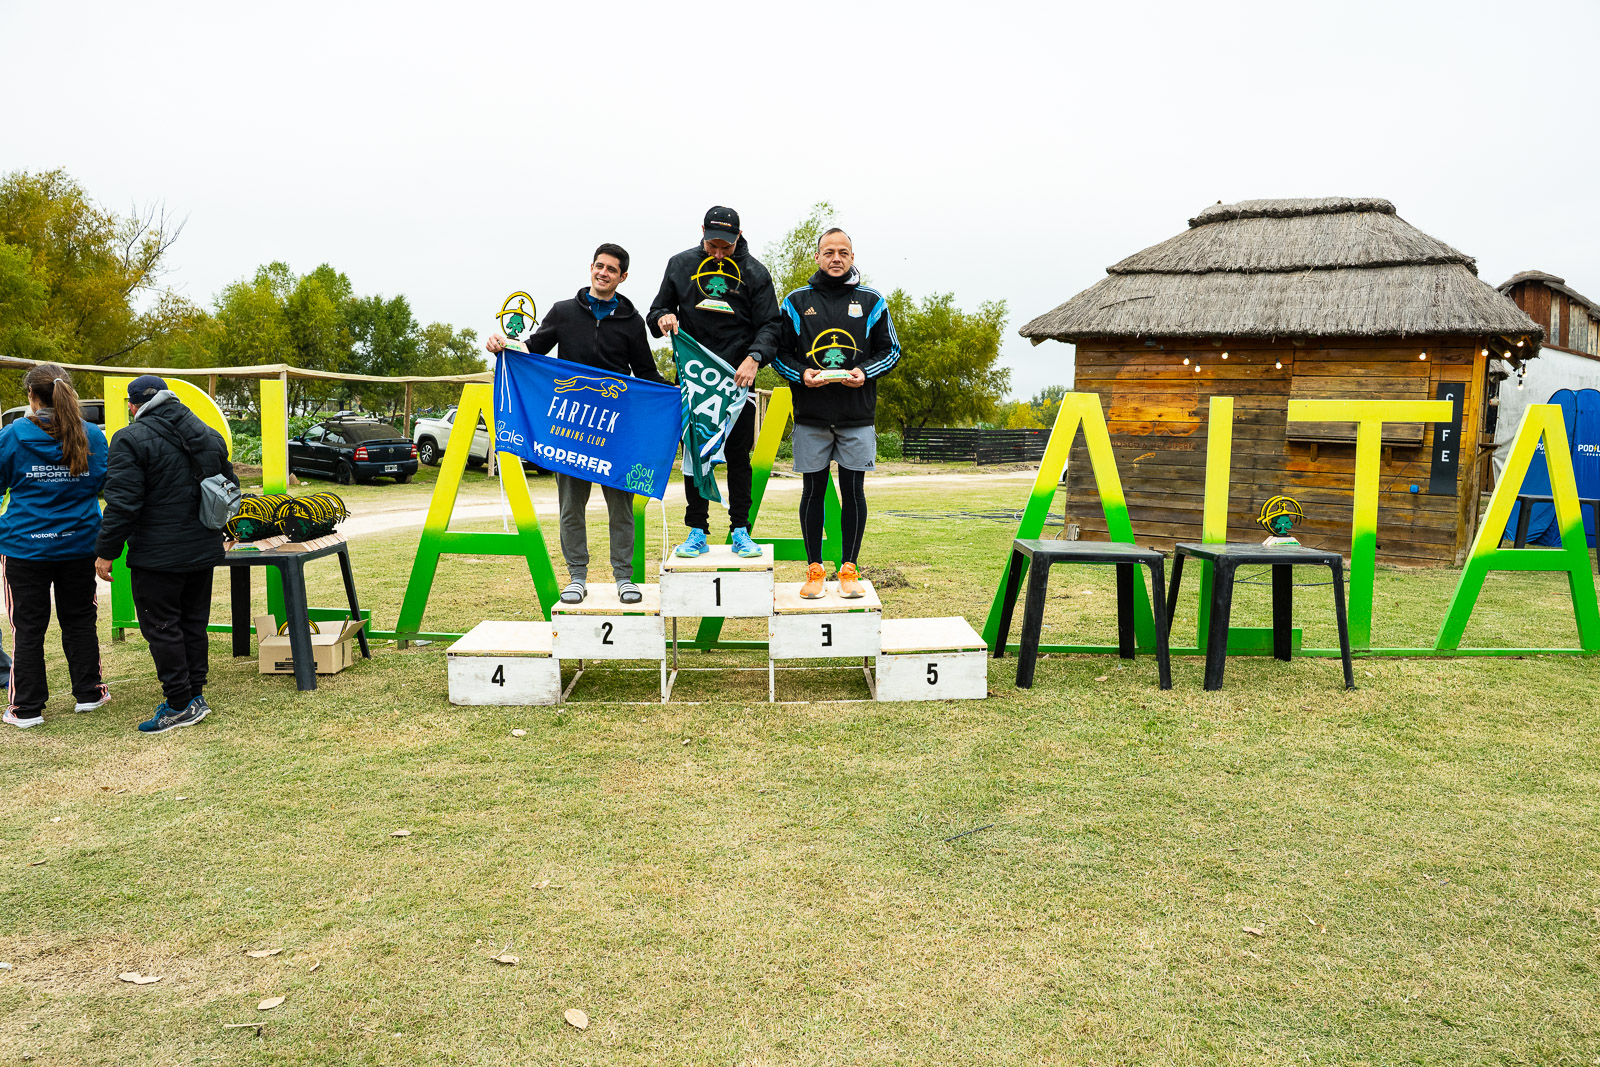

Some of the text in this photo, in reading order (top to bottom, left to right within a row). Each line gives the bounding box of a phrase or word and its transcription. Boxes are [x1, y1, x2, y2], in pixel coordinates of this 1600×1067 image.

[547, 395, 620, 434] FARTLEK
[549, 424, 606, 447] RUNNING CLUB
[1440, 392, 1454, 462] CFE
[533, 440, 612, 476] KODERER
[630, 463, 655, 483] Soy
[982, 391, 1600, 656] ALTA
[713, 577, 721, 606] 1
[601, 621, 614, 645] 2
[821, 623, 832, 646] 3
[491, 664, 506, 687] 4
[926, 662, 938, 685] 5
